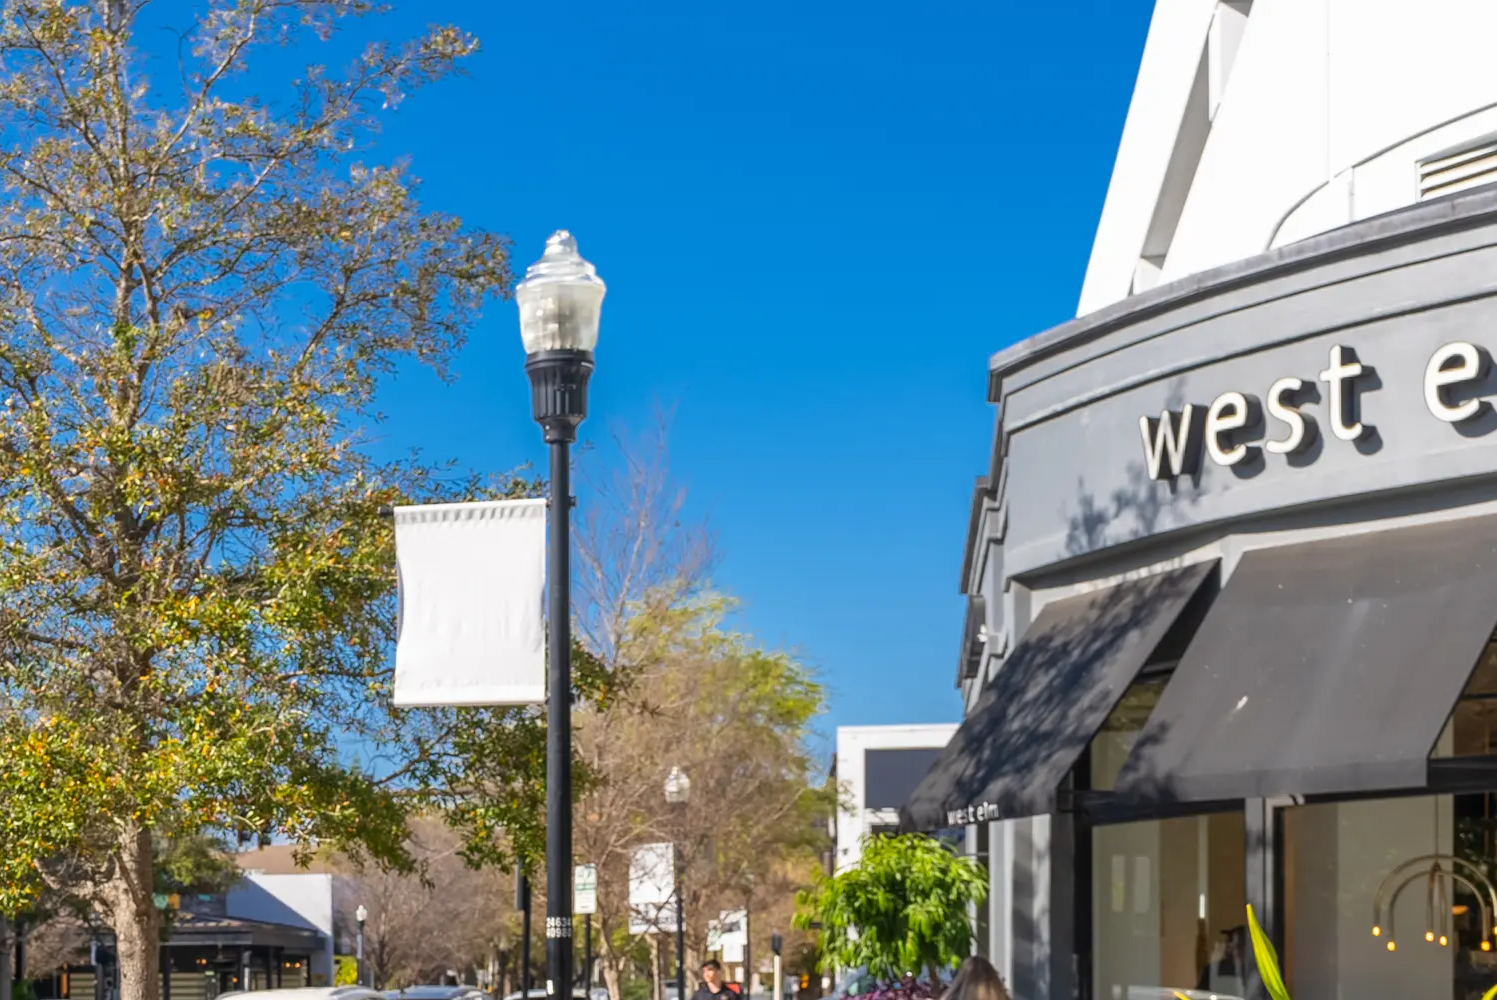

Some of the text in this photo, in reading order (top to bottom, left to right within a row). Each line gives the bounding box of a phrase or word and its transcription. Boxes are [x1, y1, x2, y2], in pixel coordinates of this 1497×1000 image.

[1138, 344, 1363, 481] west
[946, 801, 1000, 826] west elm
